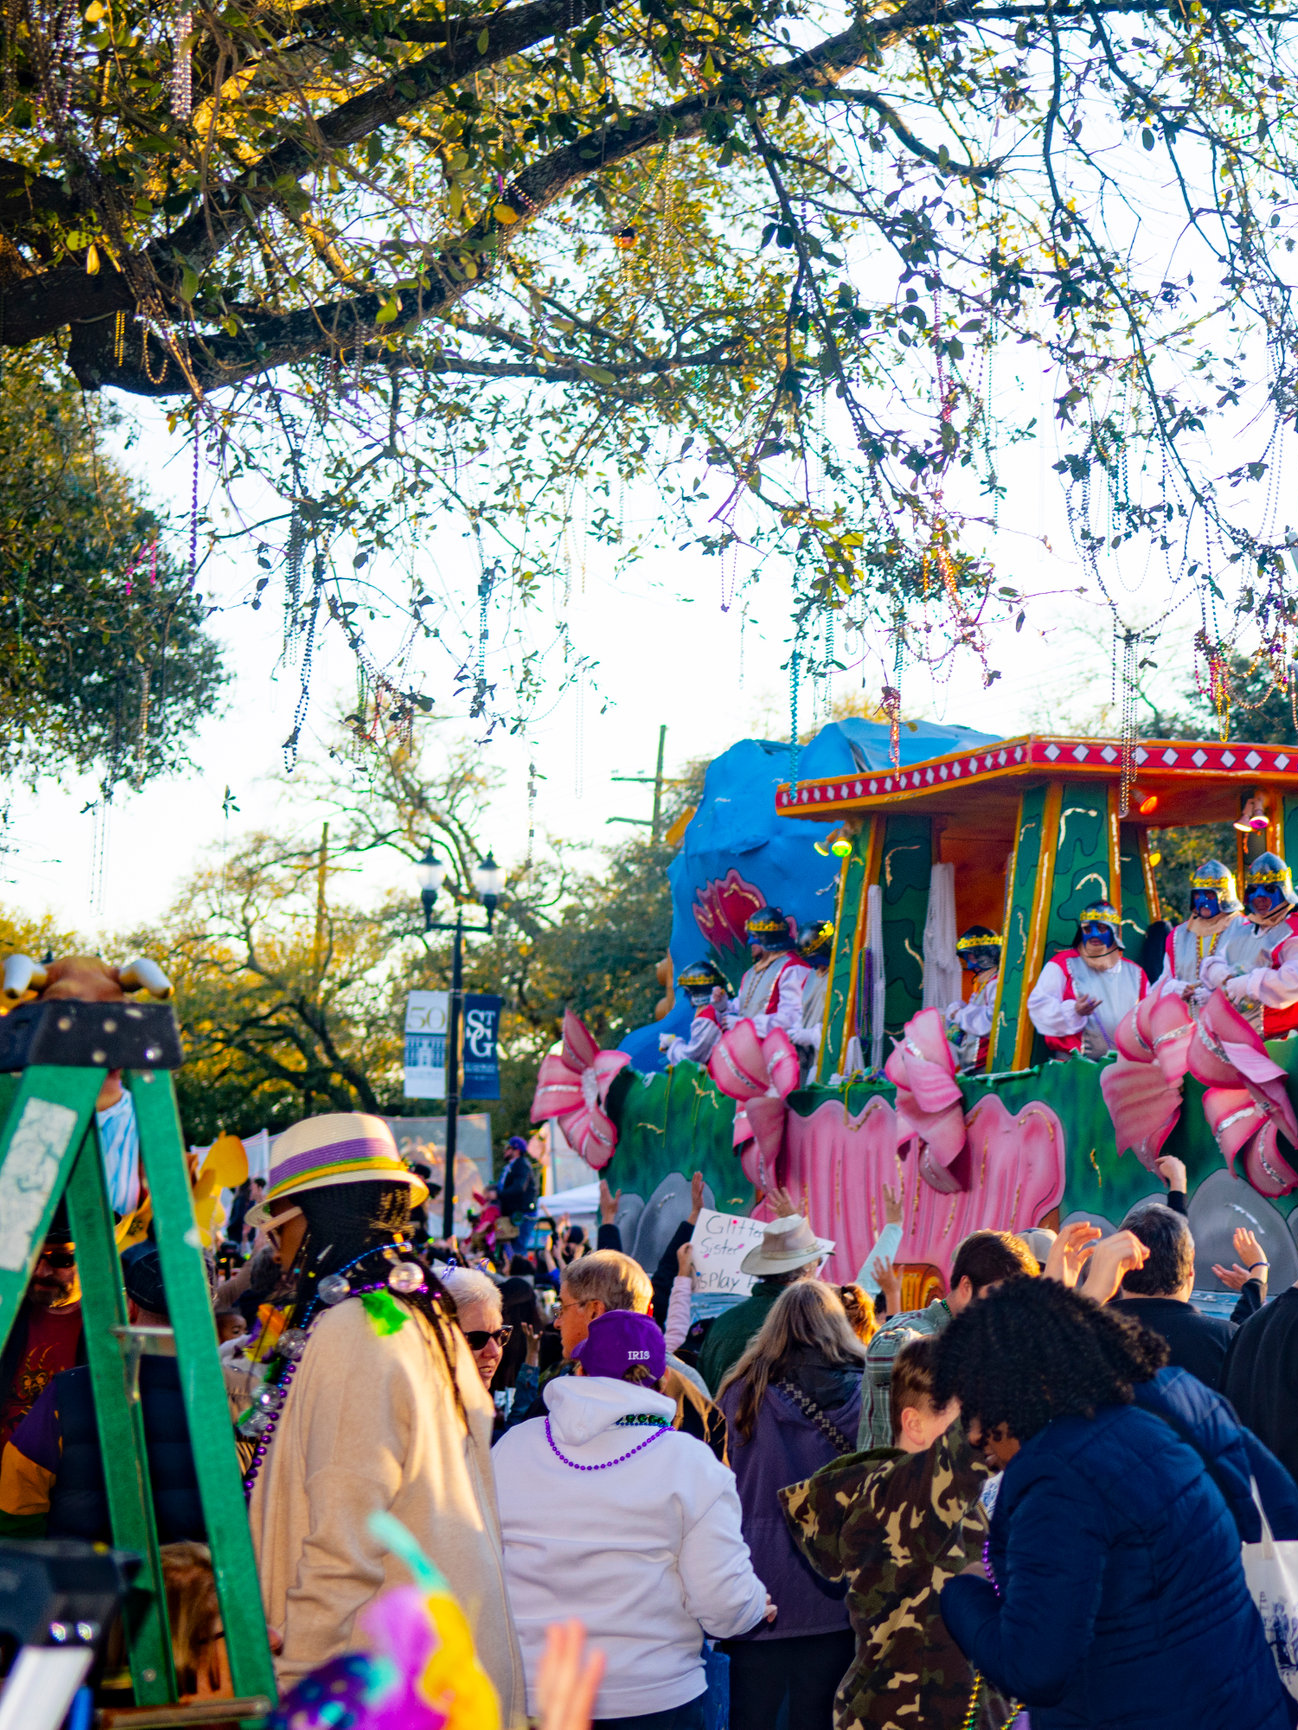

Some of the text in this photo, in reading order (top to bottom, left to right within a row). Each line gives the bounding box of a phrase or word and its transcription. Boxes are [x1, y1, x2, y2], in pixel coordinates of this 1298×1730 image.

[407, 1006, 446, 1030] 50
[700, 1237, 740, 1255] Sister
[627, 1350, 650, 1360] IRIS
